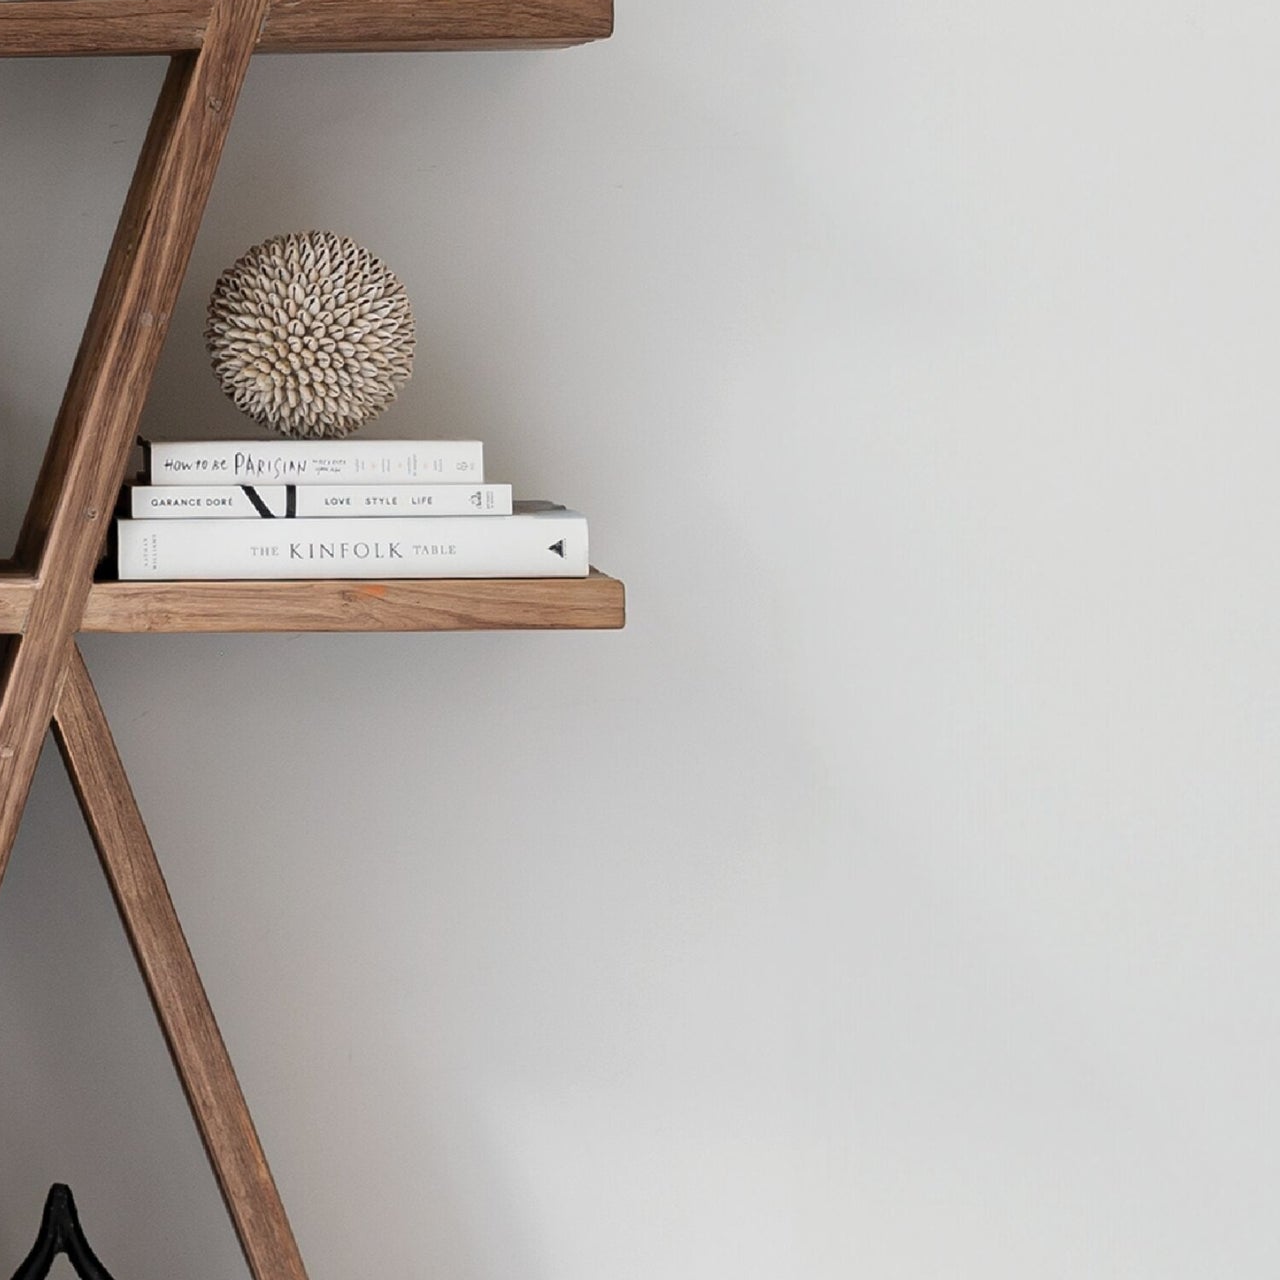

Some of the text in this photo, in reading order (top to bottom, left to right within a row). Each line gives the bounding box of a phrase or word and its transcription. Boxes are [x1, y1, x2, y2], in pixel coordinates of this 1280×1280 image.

[234, 451, 308, 480] PARISIAN
[150, 498, 202, 507] GARANCE
[324, 496, 433, 506] LOVE STYLE LIFE
[250, 542, 457, 560] THE KINFOLK TABLE
